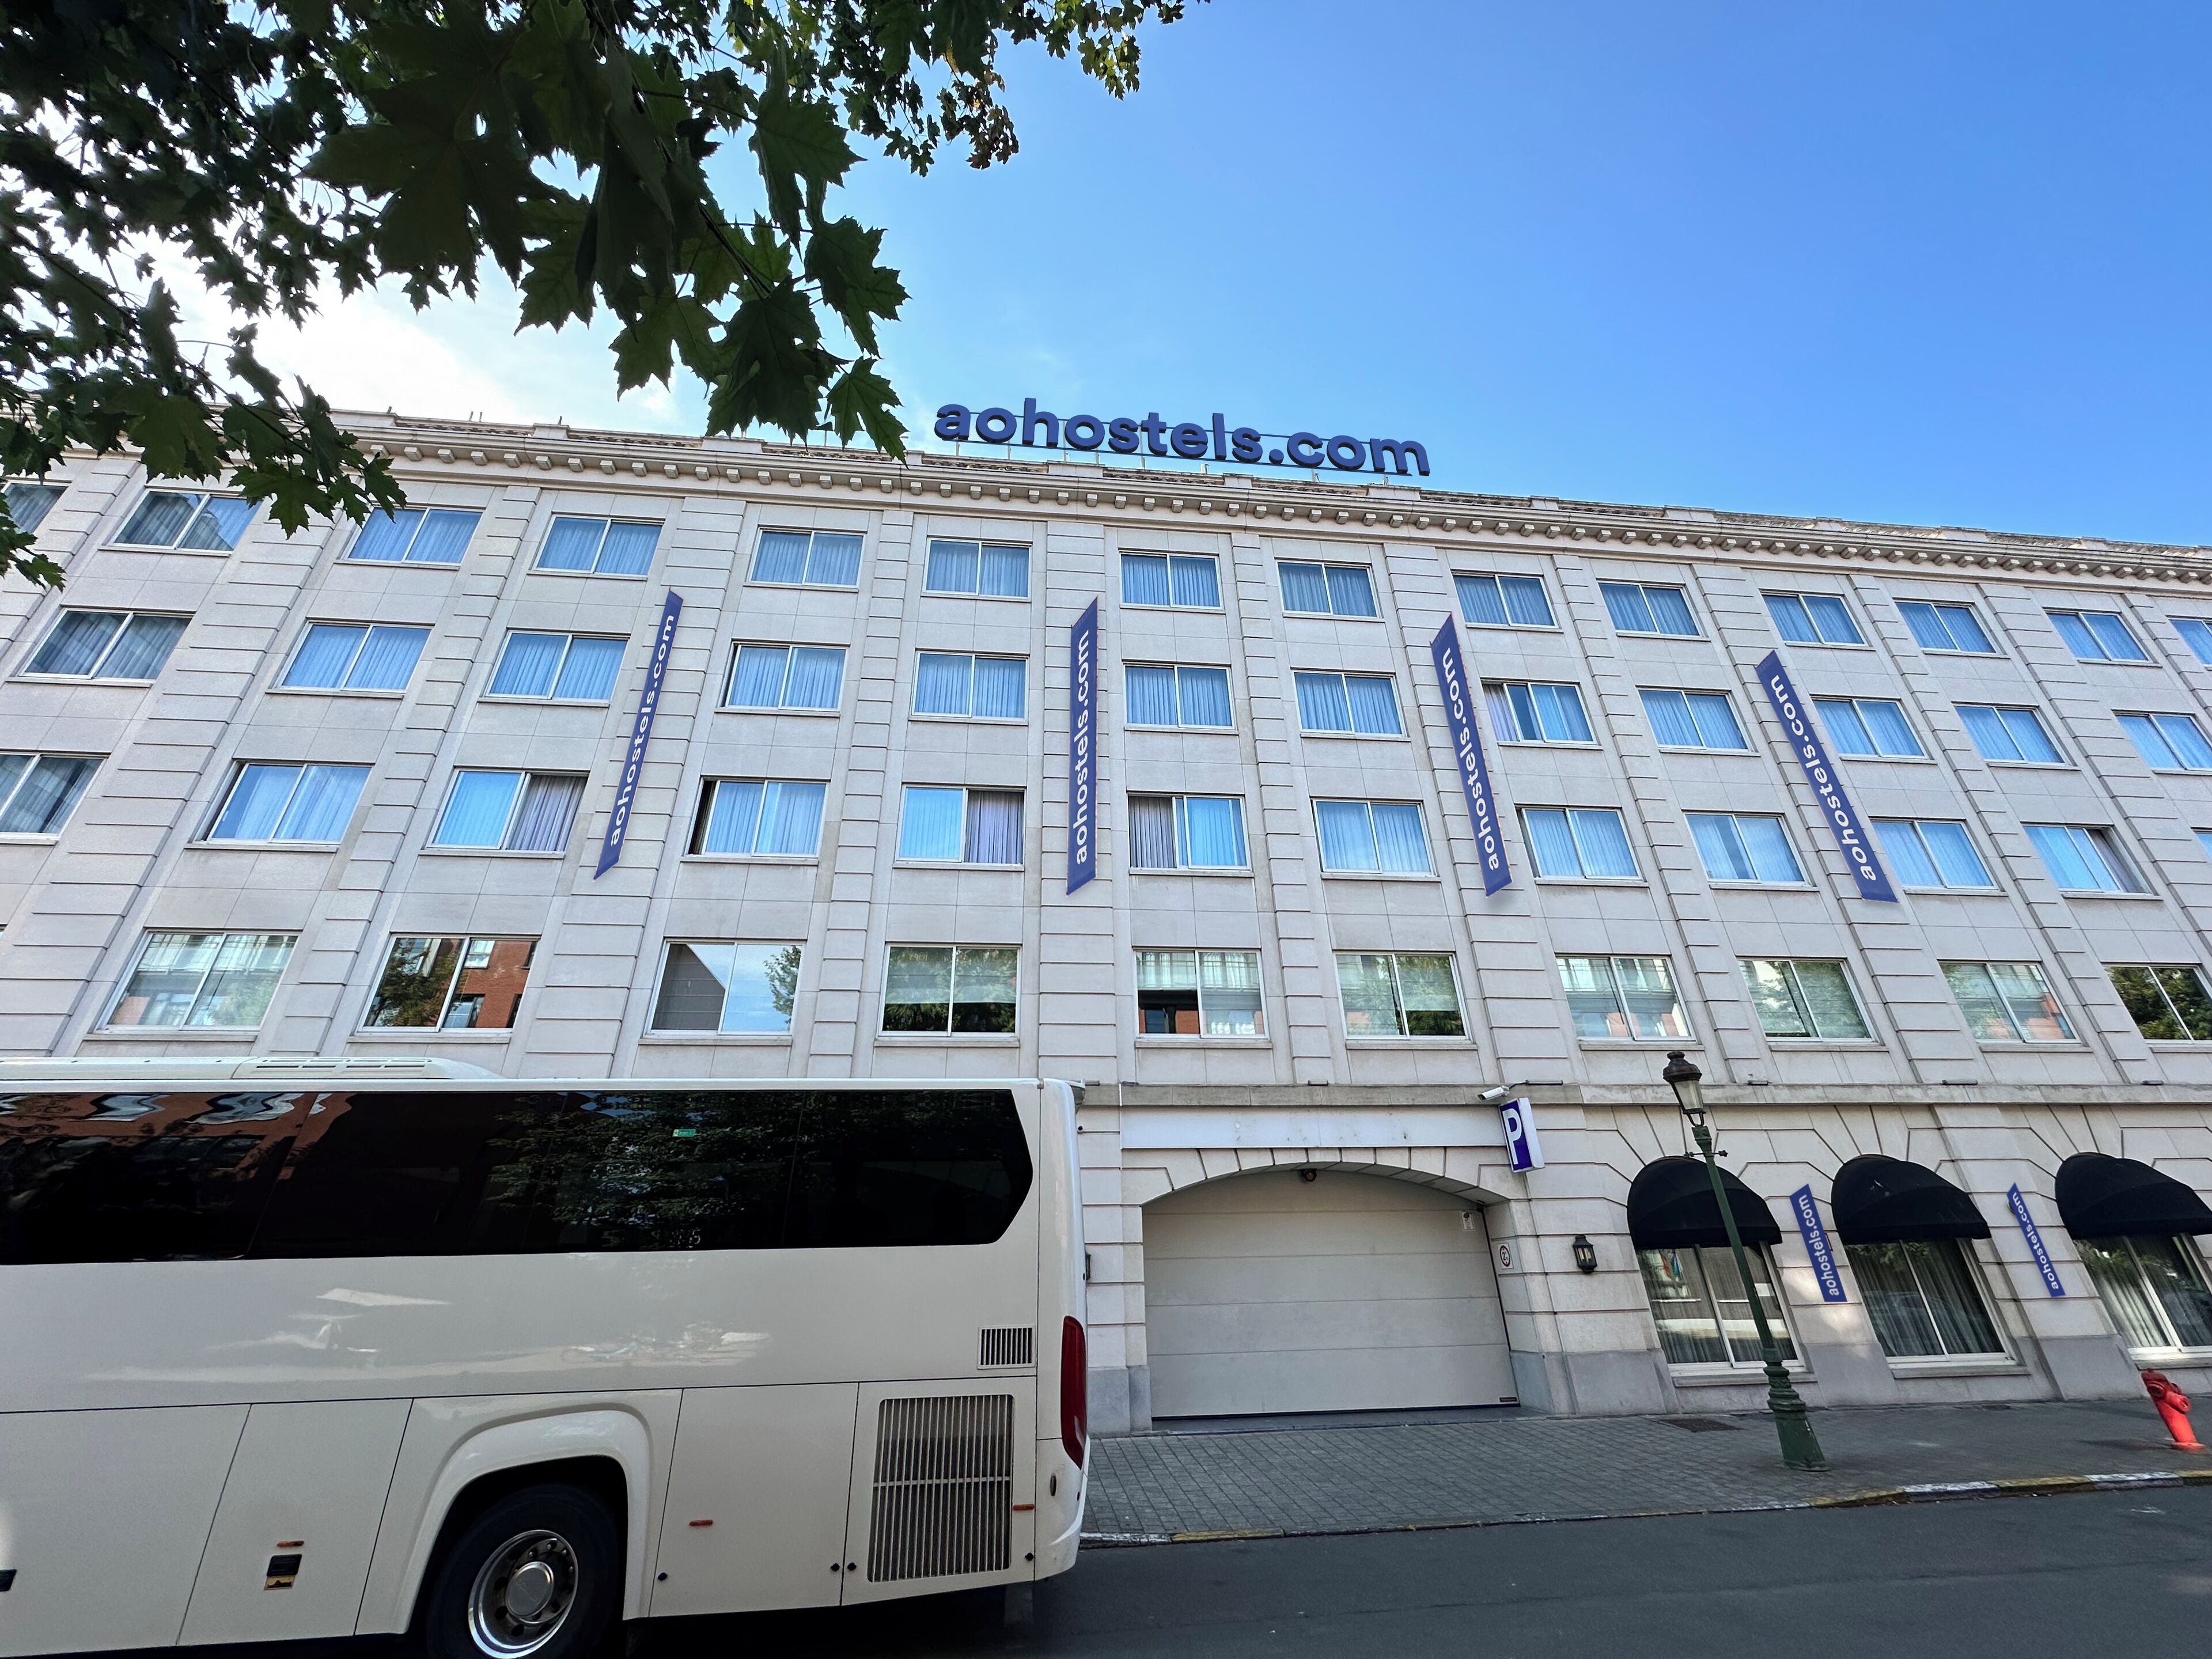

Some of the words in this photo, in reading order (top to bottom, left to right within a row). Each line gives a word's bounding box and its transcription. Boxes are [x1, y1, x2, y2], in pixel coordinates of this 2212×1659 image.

[934, 397, 1430, 476] aohostels.com
[611, 615, 674, 846] aohostels.com
[1073, 630, 1089, 865] aohostels.com
[1442, 647, 1499, 870] aohostels.com
[1771, 675, 1877, 881] aohostels.com
[1502, 1108, 1522, 1165] P
[1798, 1194, 1839, 1296] aohostels.com
[2013, 1192, 2059, 1290] aohostels.com
